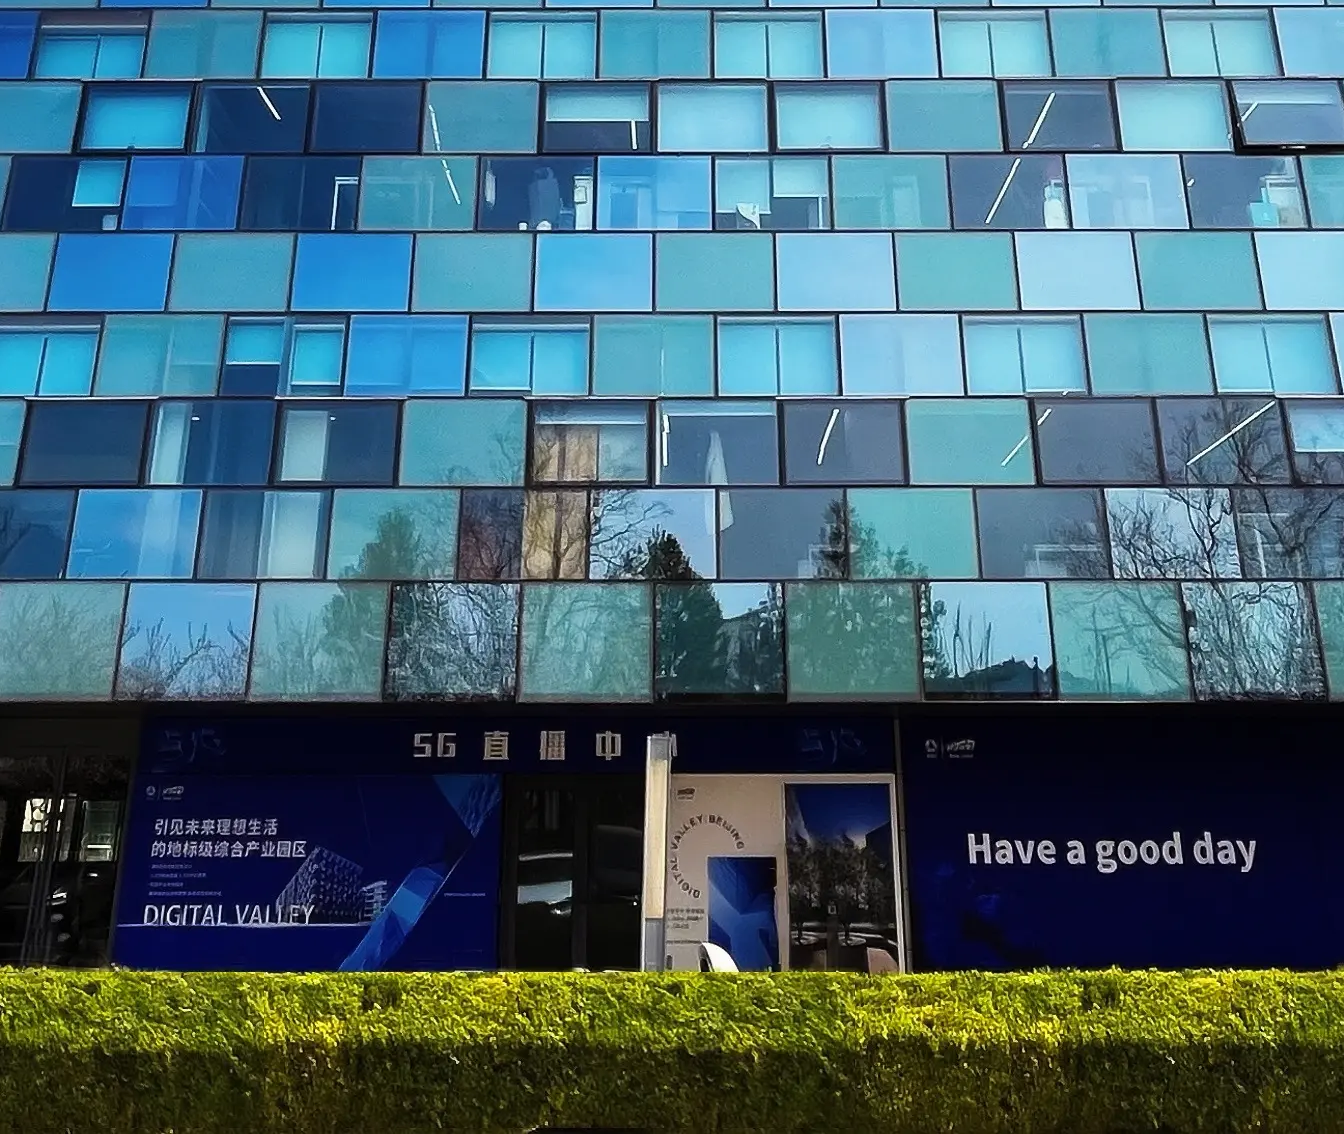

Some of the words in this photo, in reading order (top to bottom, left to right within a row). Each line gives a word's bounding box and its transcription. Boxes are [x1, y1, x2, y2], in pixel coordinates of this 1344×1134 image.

[154, 818, 278, 836] 引见未来理想生活
[670, 813, 703, 850] VALLEY
[150, 840, 306, 858] 的地标级综合产业园区
[967, 833, 1057, 865] Have
[1066, 839, 1086, 865] a
[1095, 831, 1184, 874] good
[1193, 831, 1256, 873] day
[143, 904, 228, 926] DIGITAL
[235, 904, 315, 926] VALLEY
